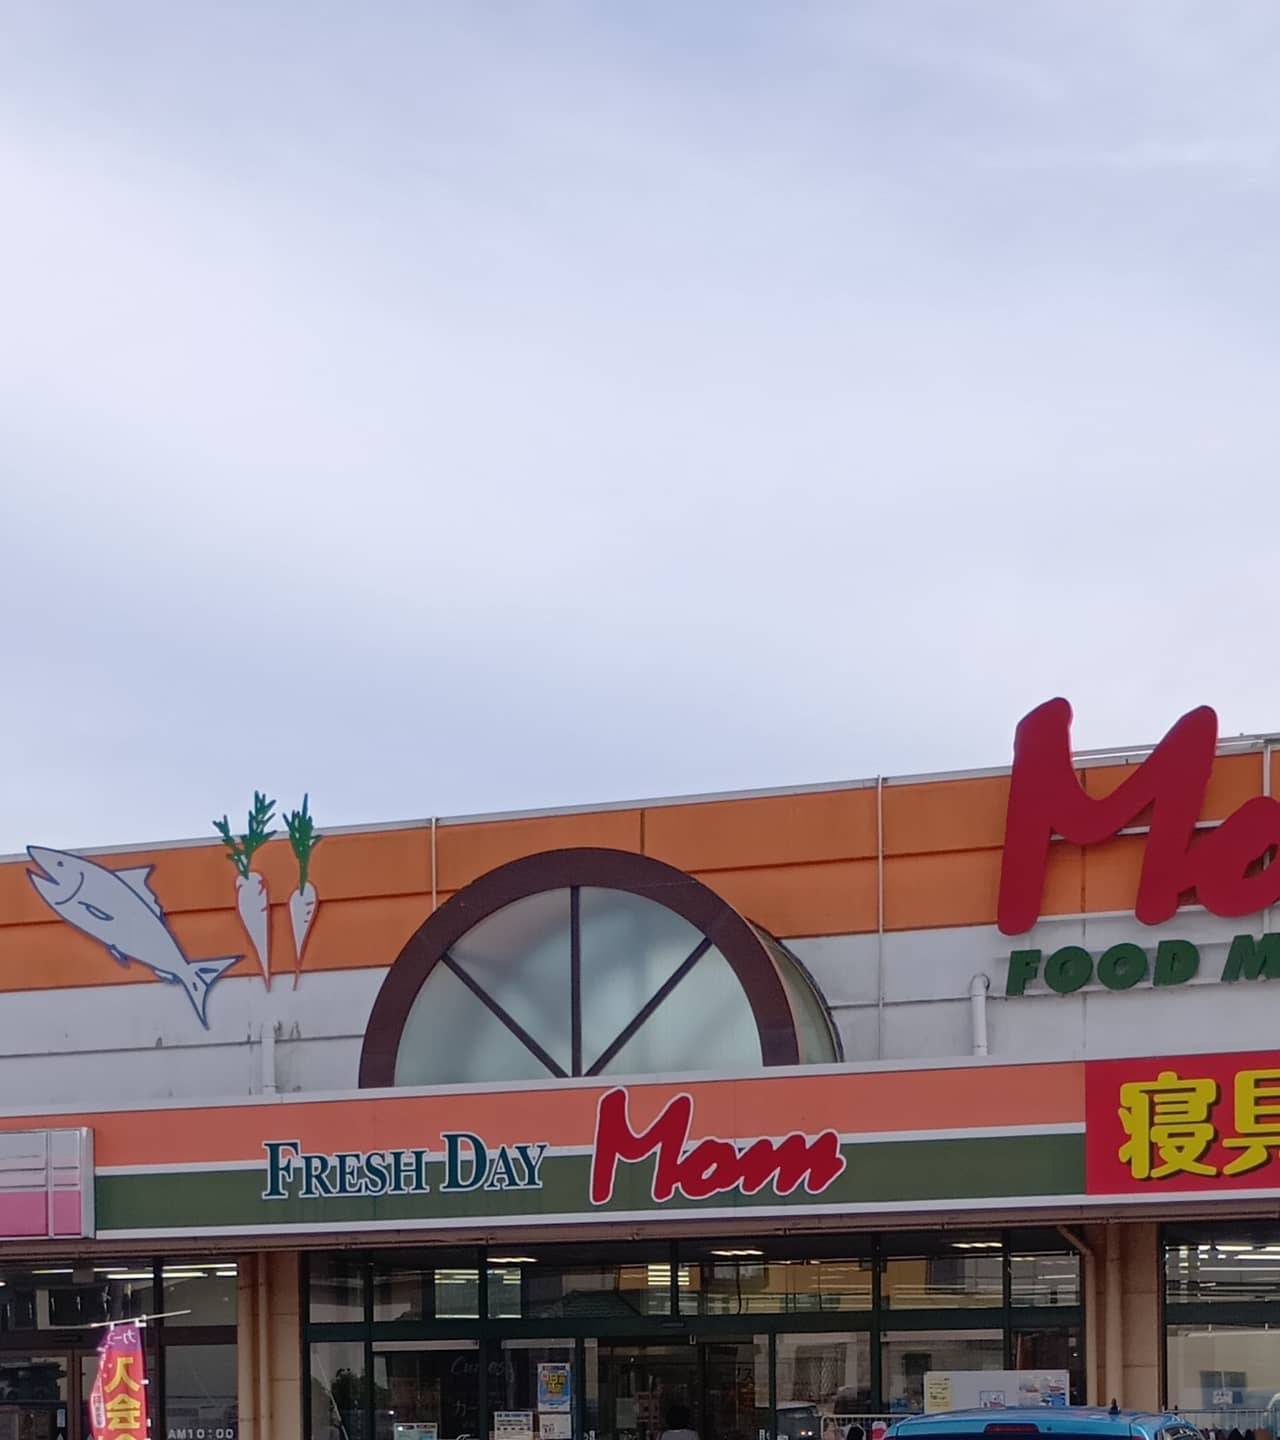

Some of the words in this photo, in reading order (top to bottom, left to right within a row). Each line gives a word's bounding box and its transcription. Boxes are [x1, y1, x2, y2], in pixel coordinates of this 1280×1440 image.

[1005, 939, 1200, 997] FOOD
[261, 1140, 429, 1199] FRESH
[439, 1131, 551, 1193] DAY
[589, 1085, 846, 1205] Mom
